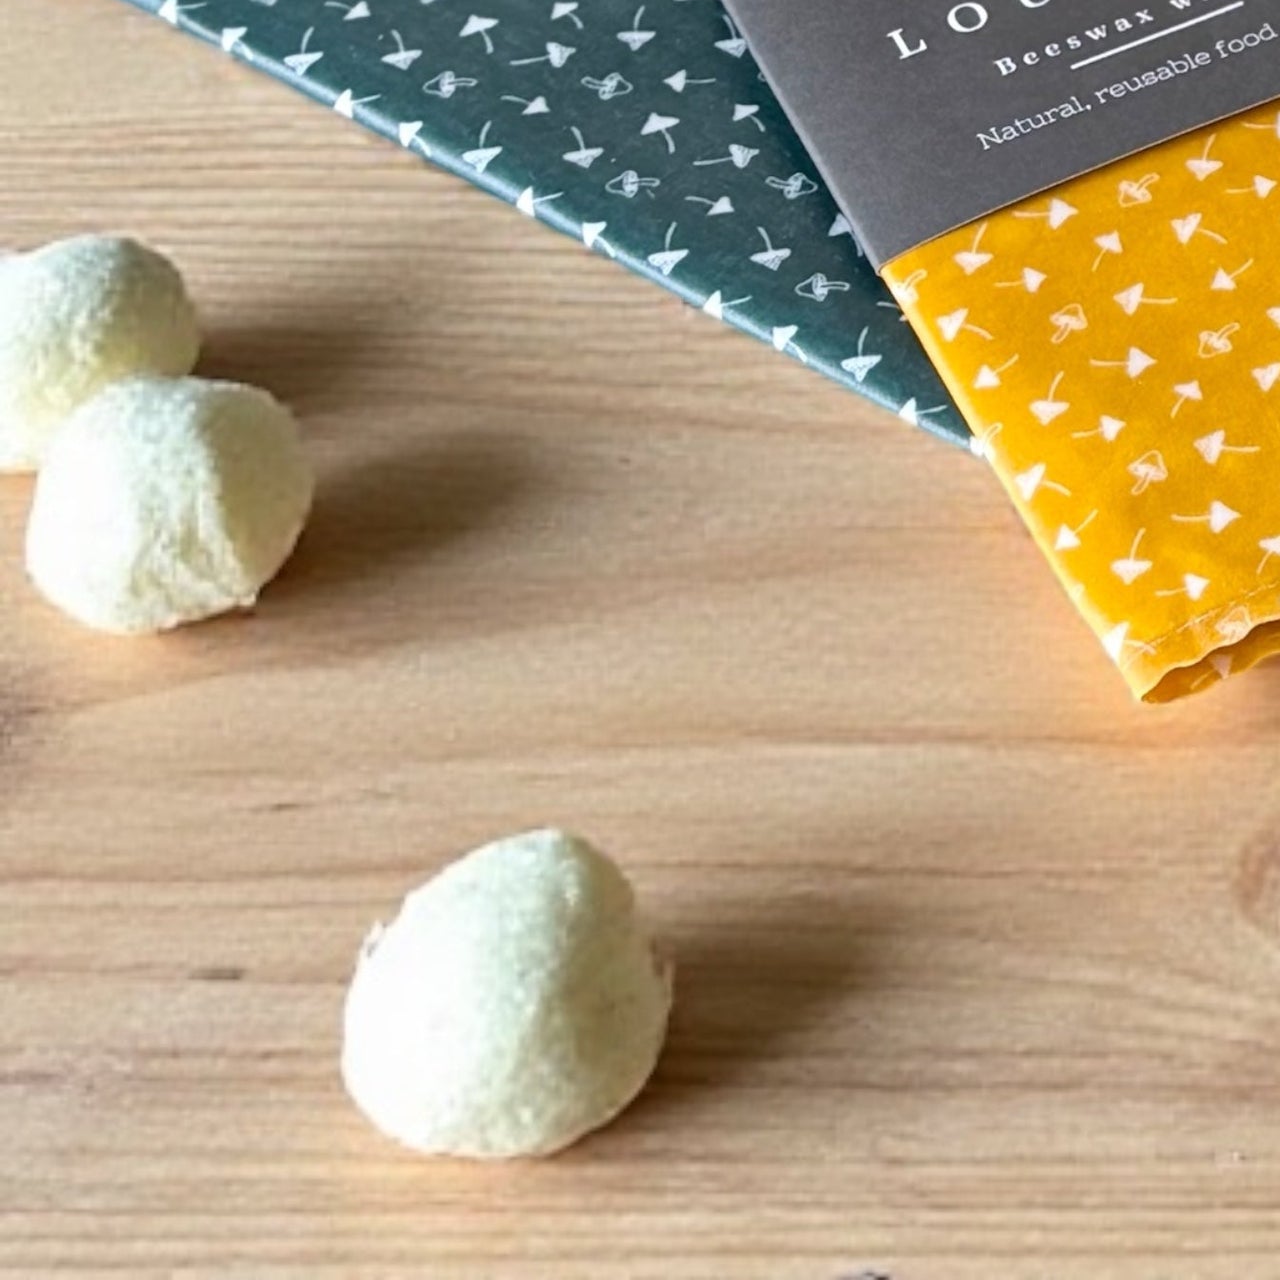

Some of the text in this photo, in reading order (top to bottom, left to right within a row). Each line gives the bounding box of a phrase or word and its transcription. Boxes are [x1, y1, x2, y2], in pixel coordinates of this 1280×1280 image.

[975, 96, 1092, 150] Natural,
[1094, 52, 1212, 104] reusable
[1214, 22, 1279, 59] food
[992, 8, 1154, 76] Beeswax
